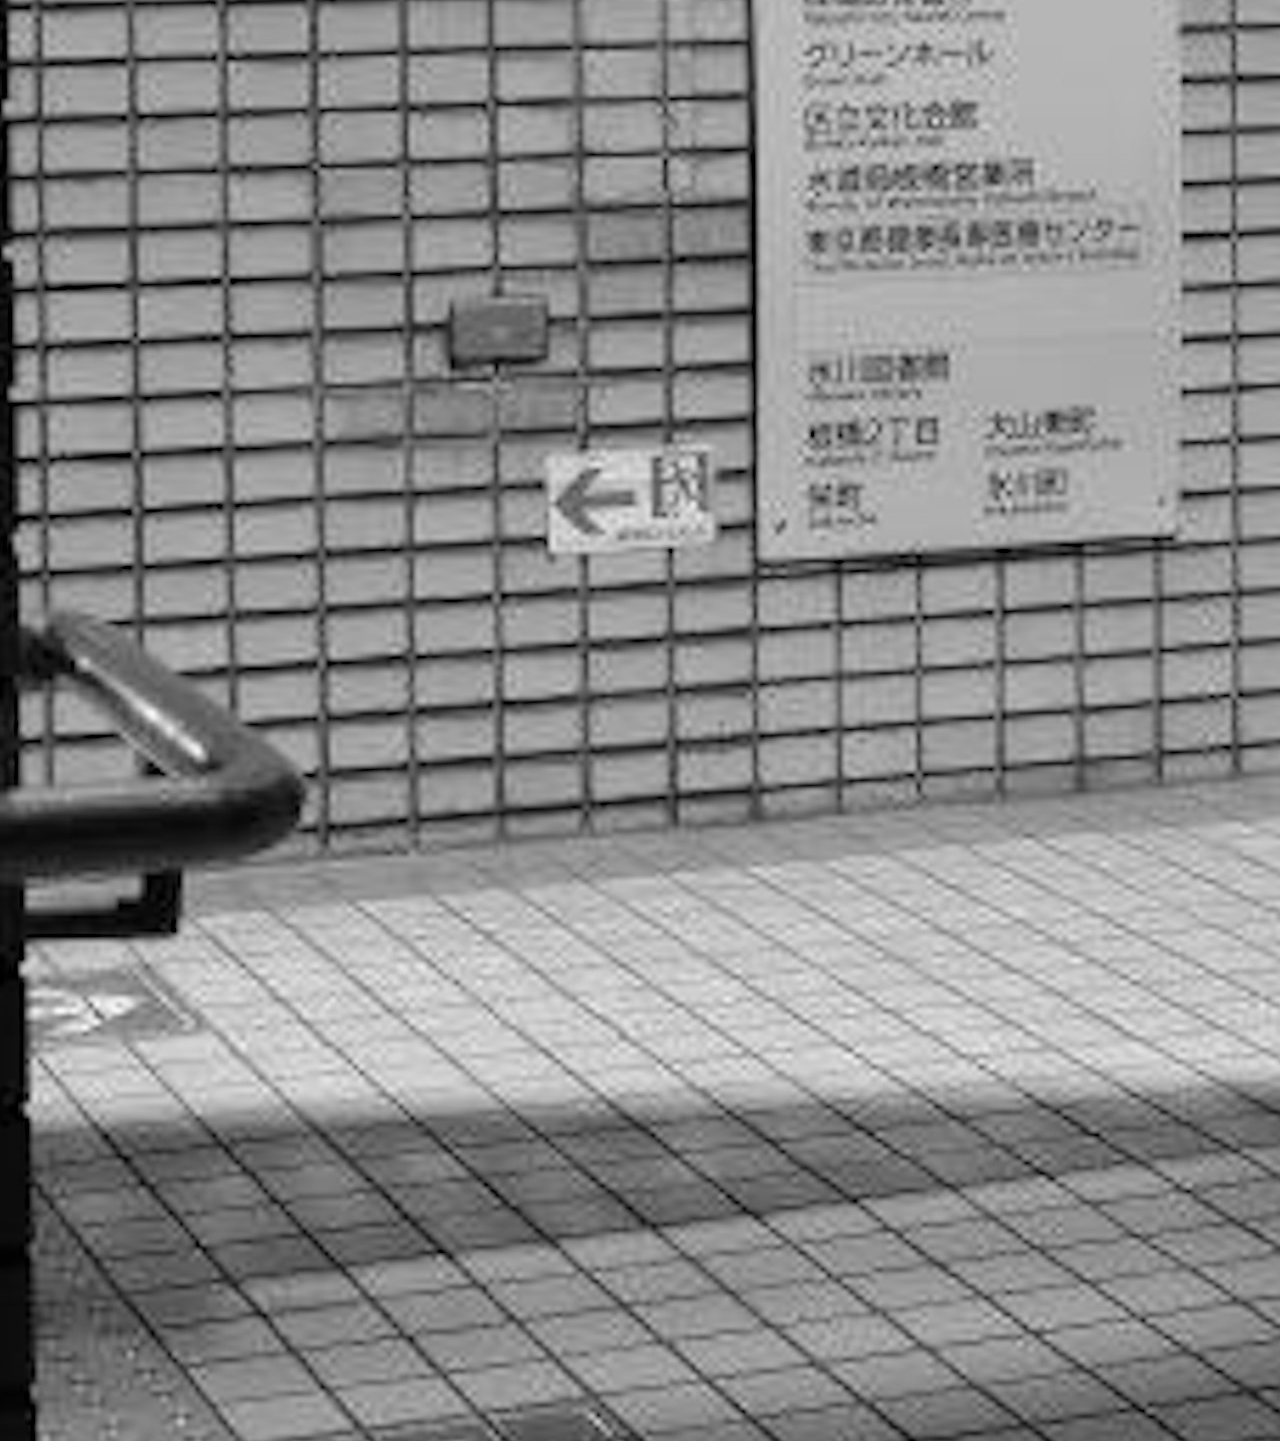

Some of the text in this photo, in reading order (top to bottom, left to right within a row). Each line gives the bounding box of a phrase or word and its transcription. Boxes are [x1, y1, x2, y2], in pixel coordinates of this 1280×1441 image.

[803, 38, 996, 69] グリーンホール
[803, 100, 979, 133] 区立文化会館
